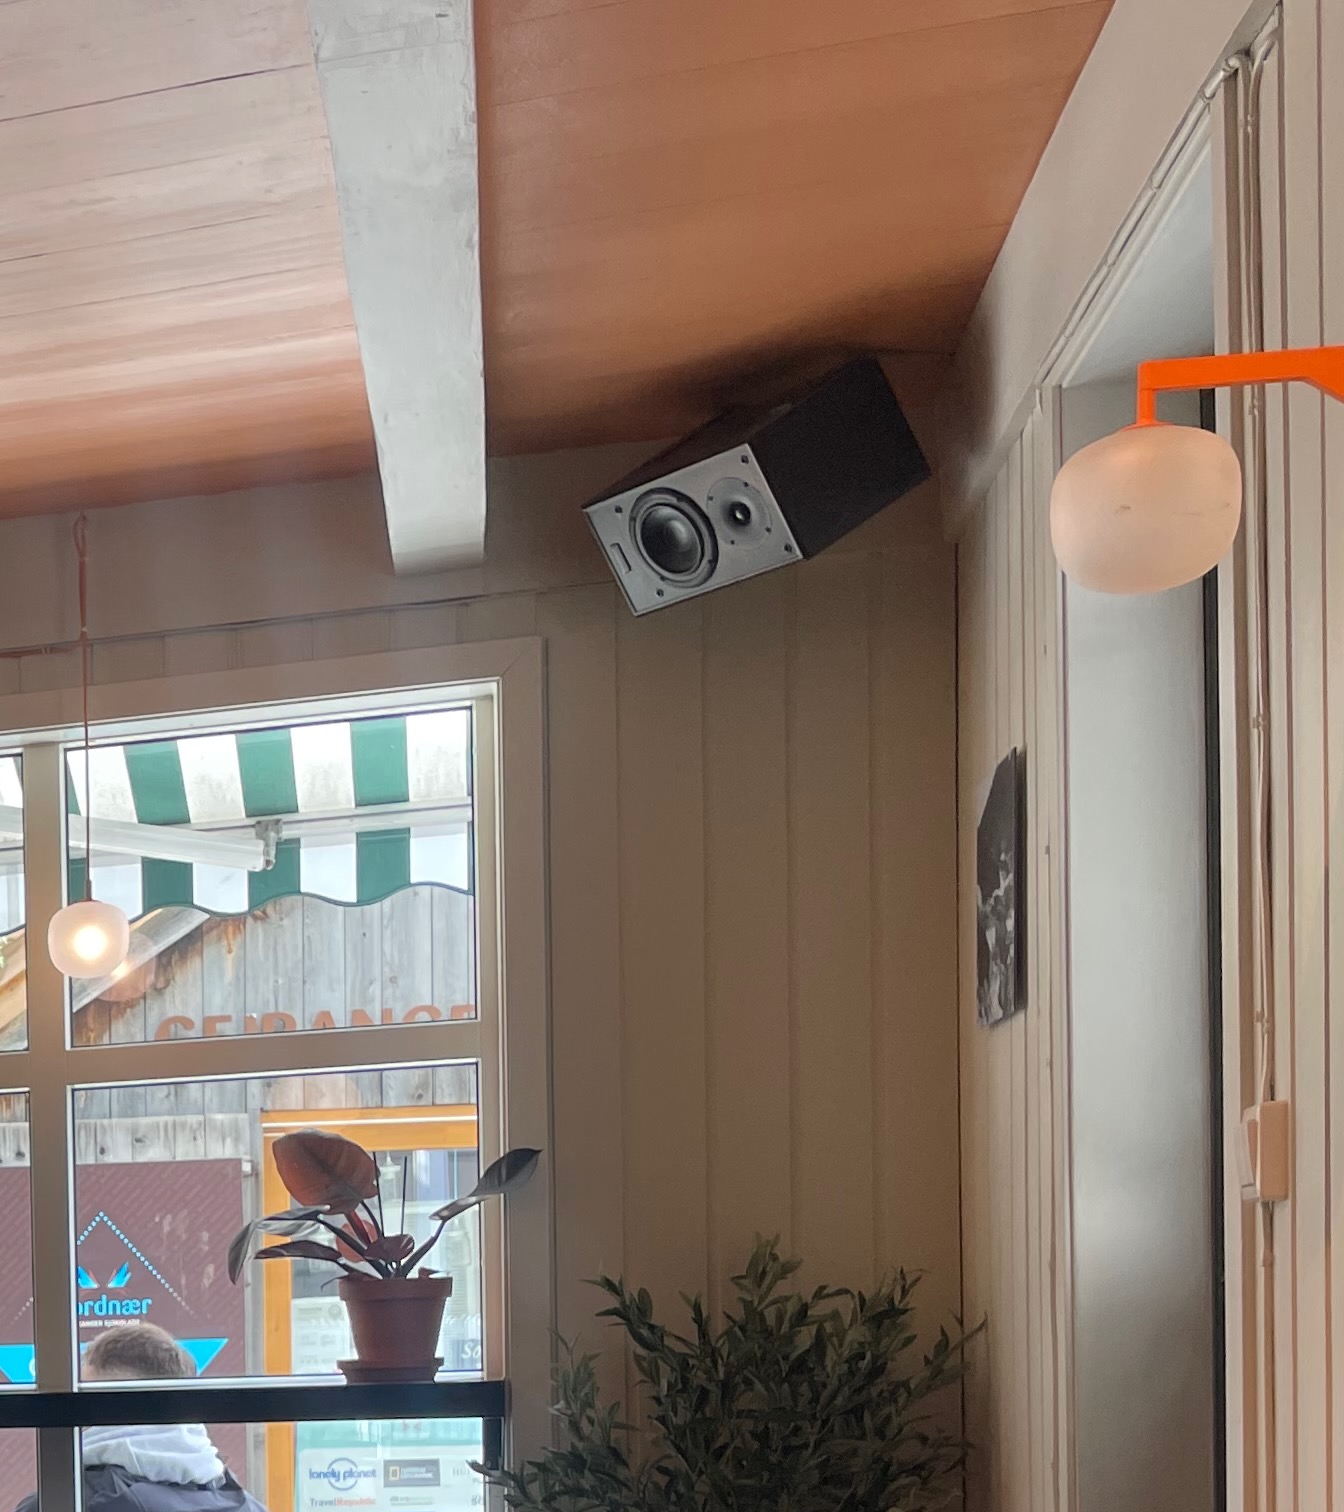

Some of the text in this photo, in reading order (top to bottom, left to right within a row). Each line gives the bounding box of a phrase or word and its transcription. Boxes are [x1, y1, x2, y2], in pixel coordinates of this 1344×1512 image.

[78, 1294, 152, 1316] rdnær
[309, 1467, 377, 1482] lonely planet
